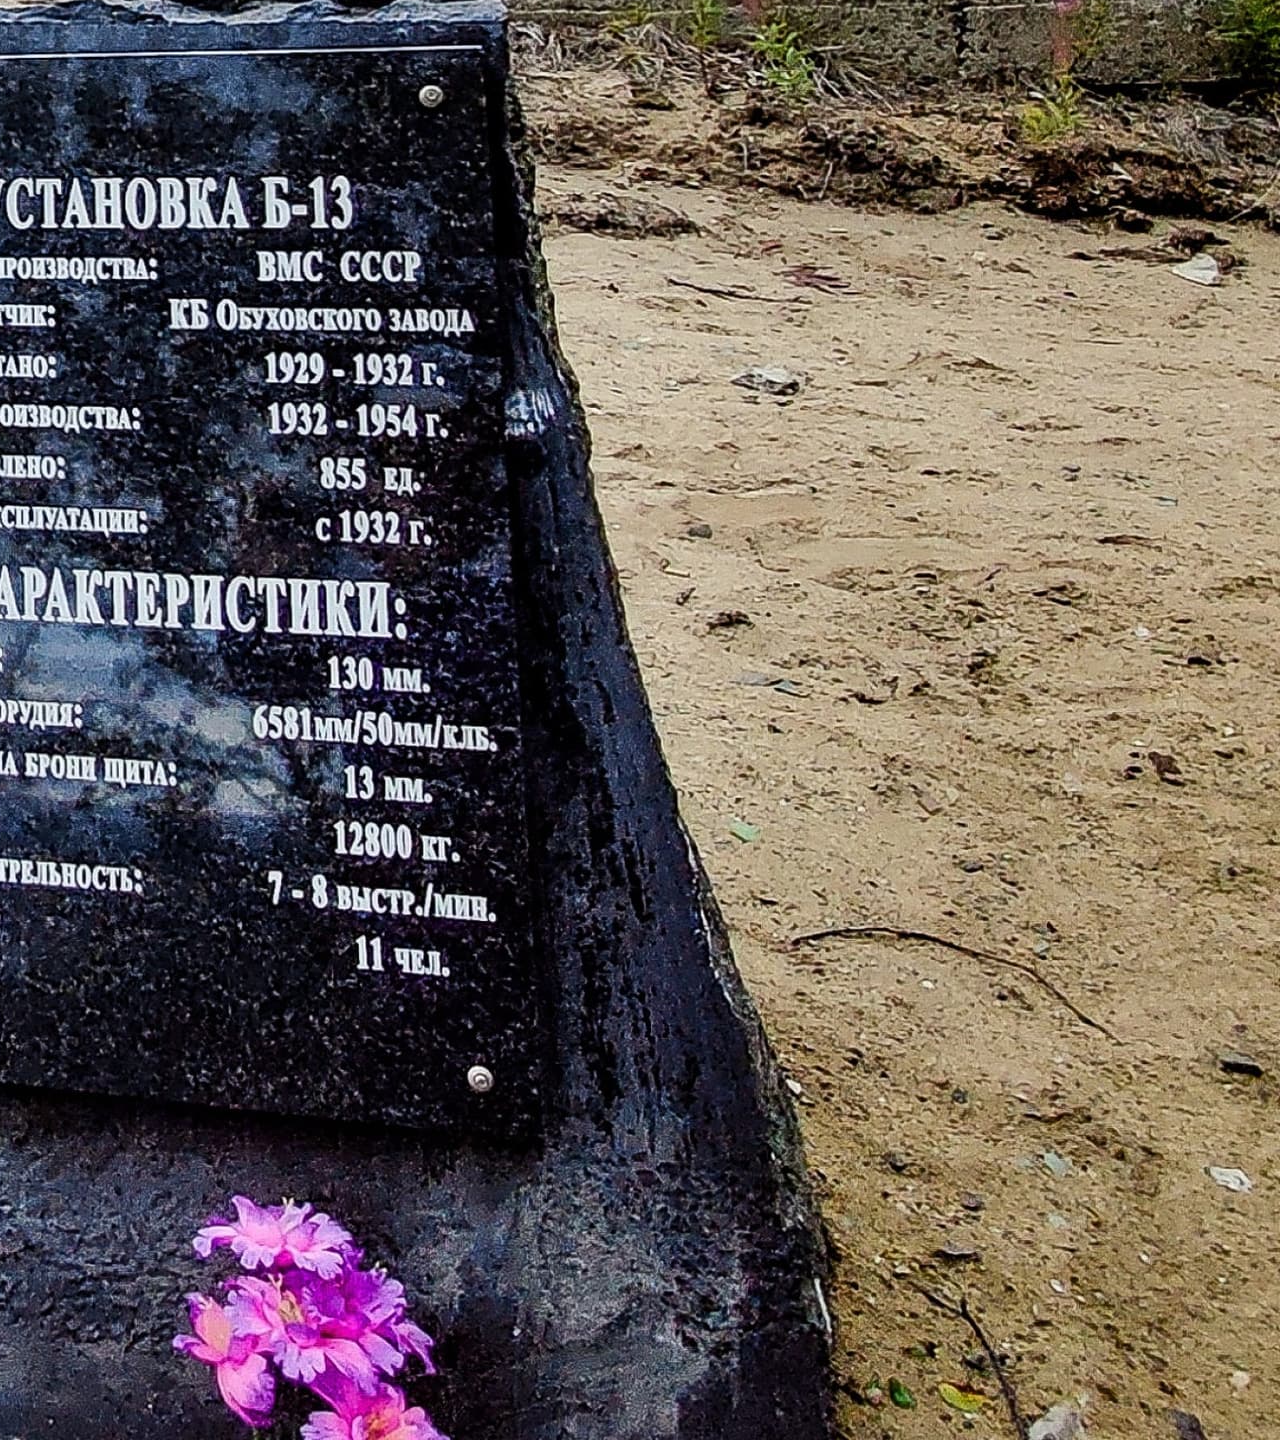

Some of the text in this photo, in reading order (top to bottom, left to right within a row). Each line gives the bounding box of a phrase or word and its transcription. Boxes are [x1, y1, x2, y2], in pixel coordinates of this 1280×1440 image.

[263, 176, 353, 229] Б-13
[257, 250, 421, 283] ВМС СССР
[169, 298, 207, 331] КБ
[264, 352, 323, 385] 1929
[353, 353, 413, 386] 1932
[269, 403, 327, 435] 1932
[357, 403, 417, 437] 1954
[320, 458, 366, 491] 855
[339, 512, 401, 543] 1932
[327, 656, 373, 691] 130
[344, 765, 374, 799] 13
[333, 821, 413, 859] 12800
[268, 870, 282, 904] 7
[311, 874, 328, 907] 8
[355, 937, 382, 971] 11
